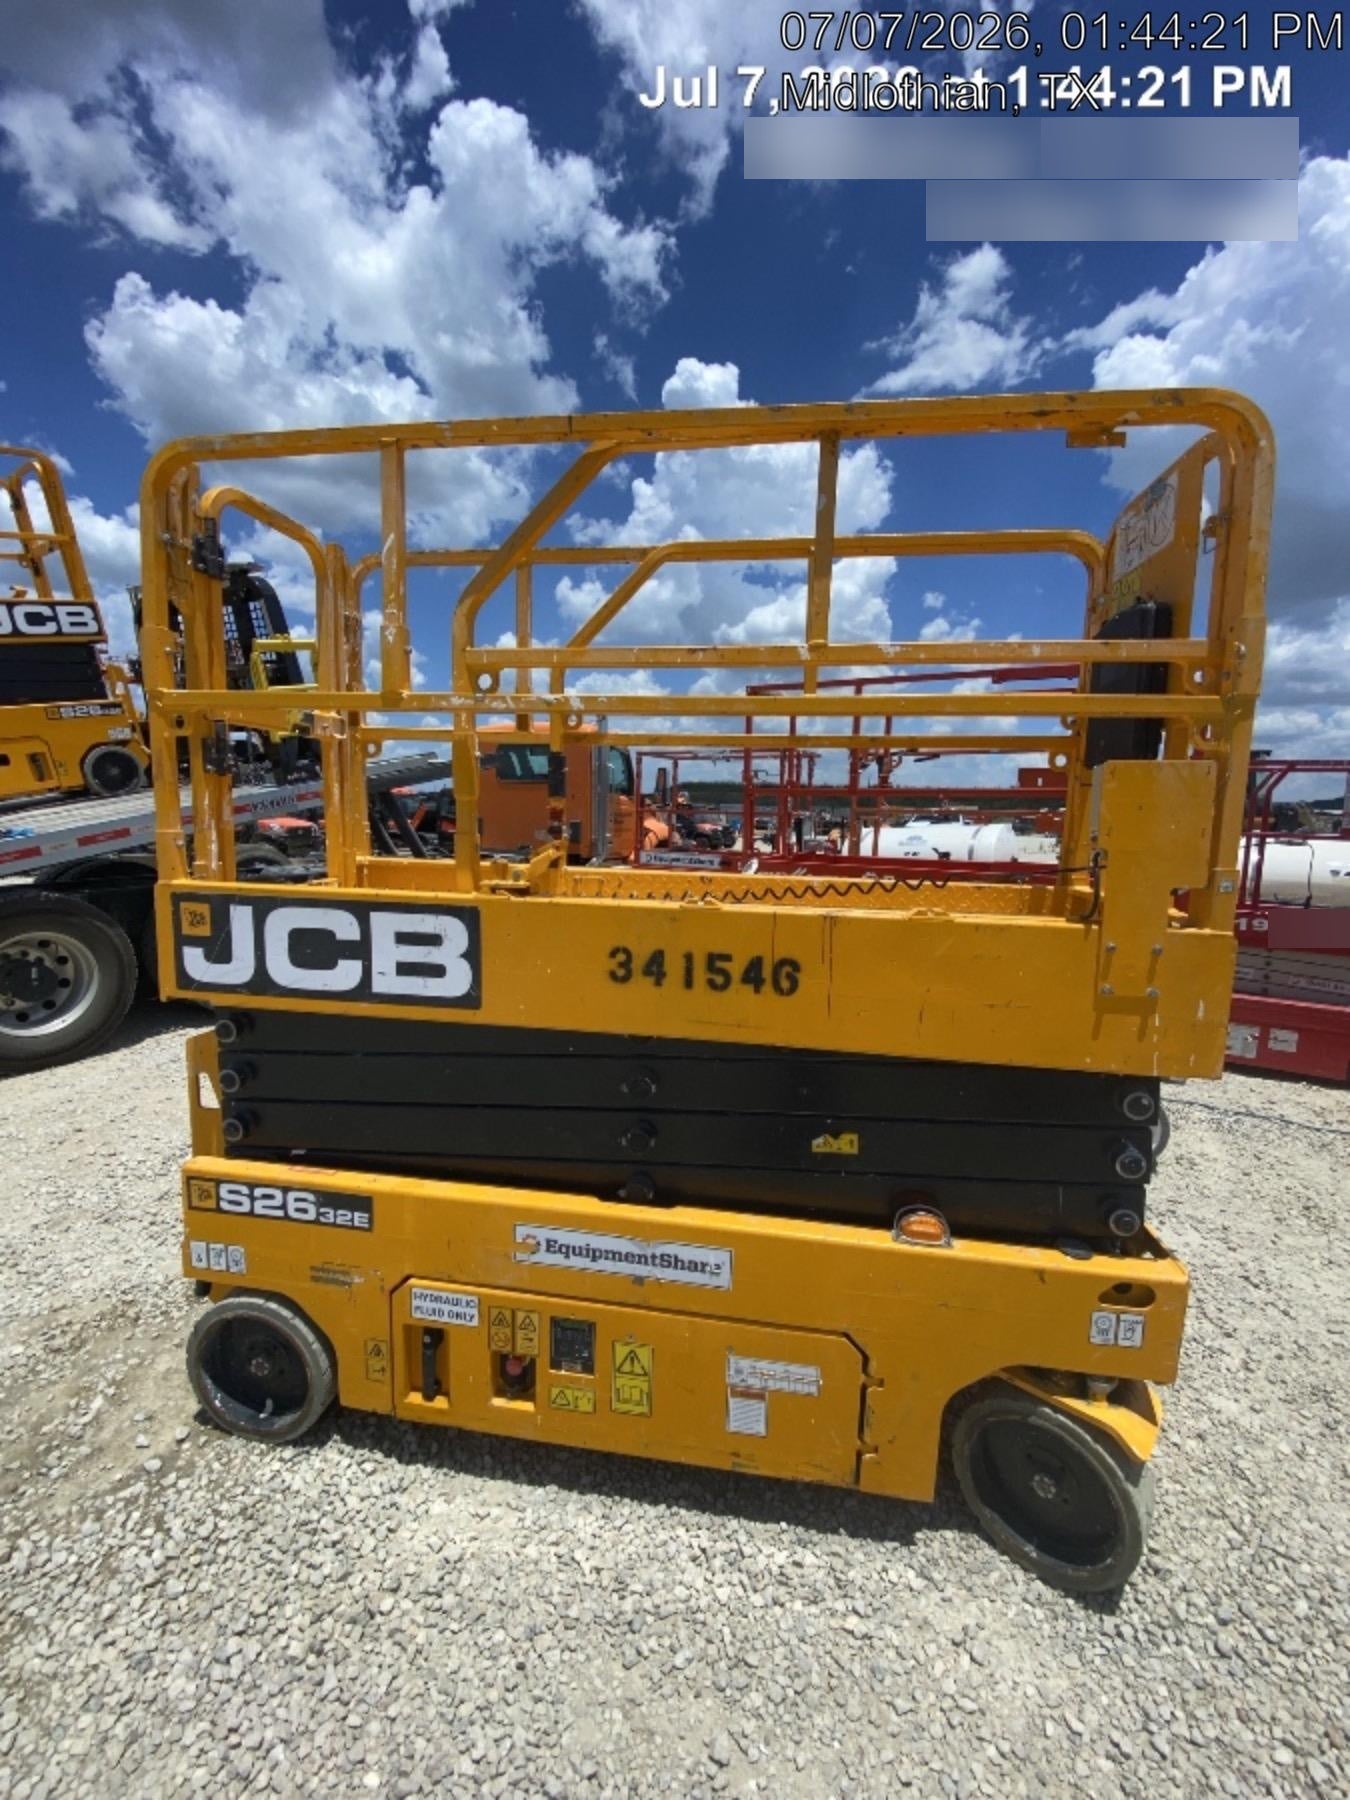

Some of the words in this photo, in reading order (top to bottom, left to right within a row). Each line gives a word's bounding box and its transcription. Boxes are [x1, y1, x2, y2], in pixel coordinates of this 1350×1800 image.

[182, 904, 473, 998] JCB
[608, 945, 803, 998] 341546
[545, 1238, 723, 1275] EquipmentShare
[414, 1291, 477, 1308] HYDRAULIC
[414, 1305, 446, 1318] FLUID
[447, 1309, 476, 1323] ONLY
